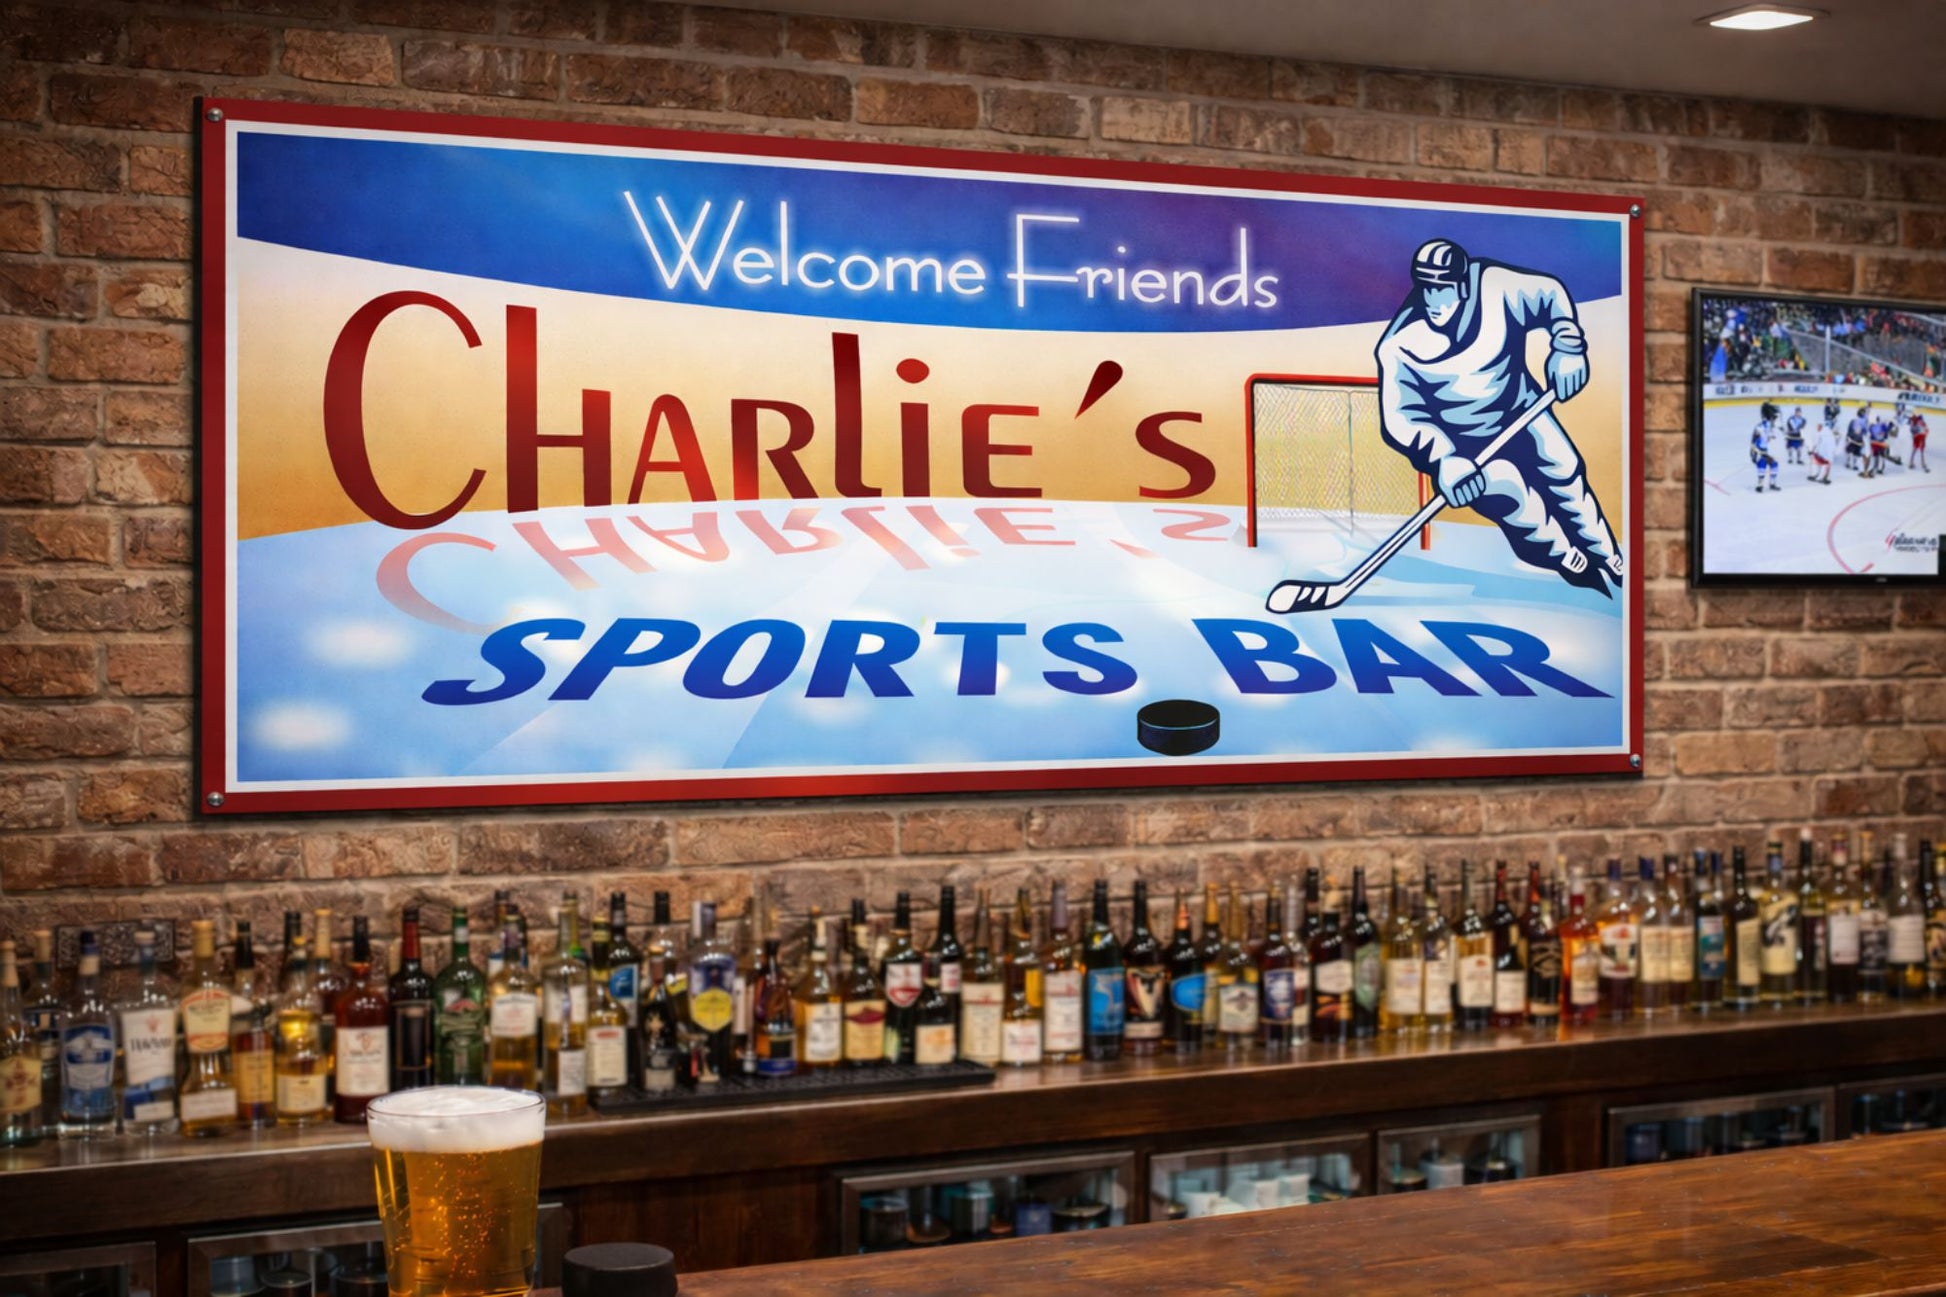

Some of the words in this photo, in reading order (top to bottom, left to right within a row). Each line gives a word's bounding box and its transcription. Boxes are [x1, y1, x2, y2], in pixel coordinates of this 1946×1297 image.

[623, 190, 988, 296] Welcome
[1006, 213, 1280, 309] Friends
[421, 617, 1138, 706] SPORTS
[1192, 618, 1616, 698] BAR
